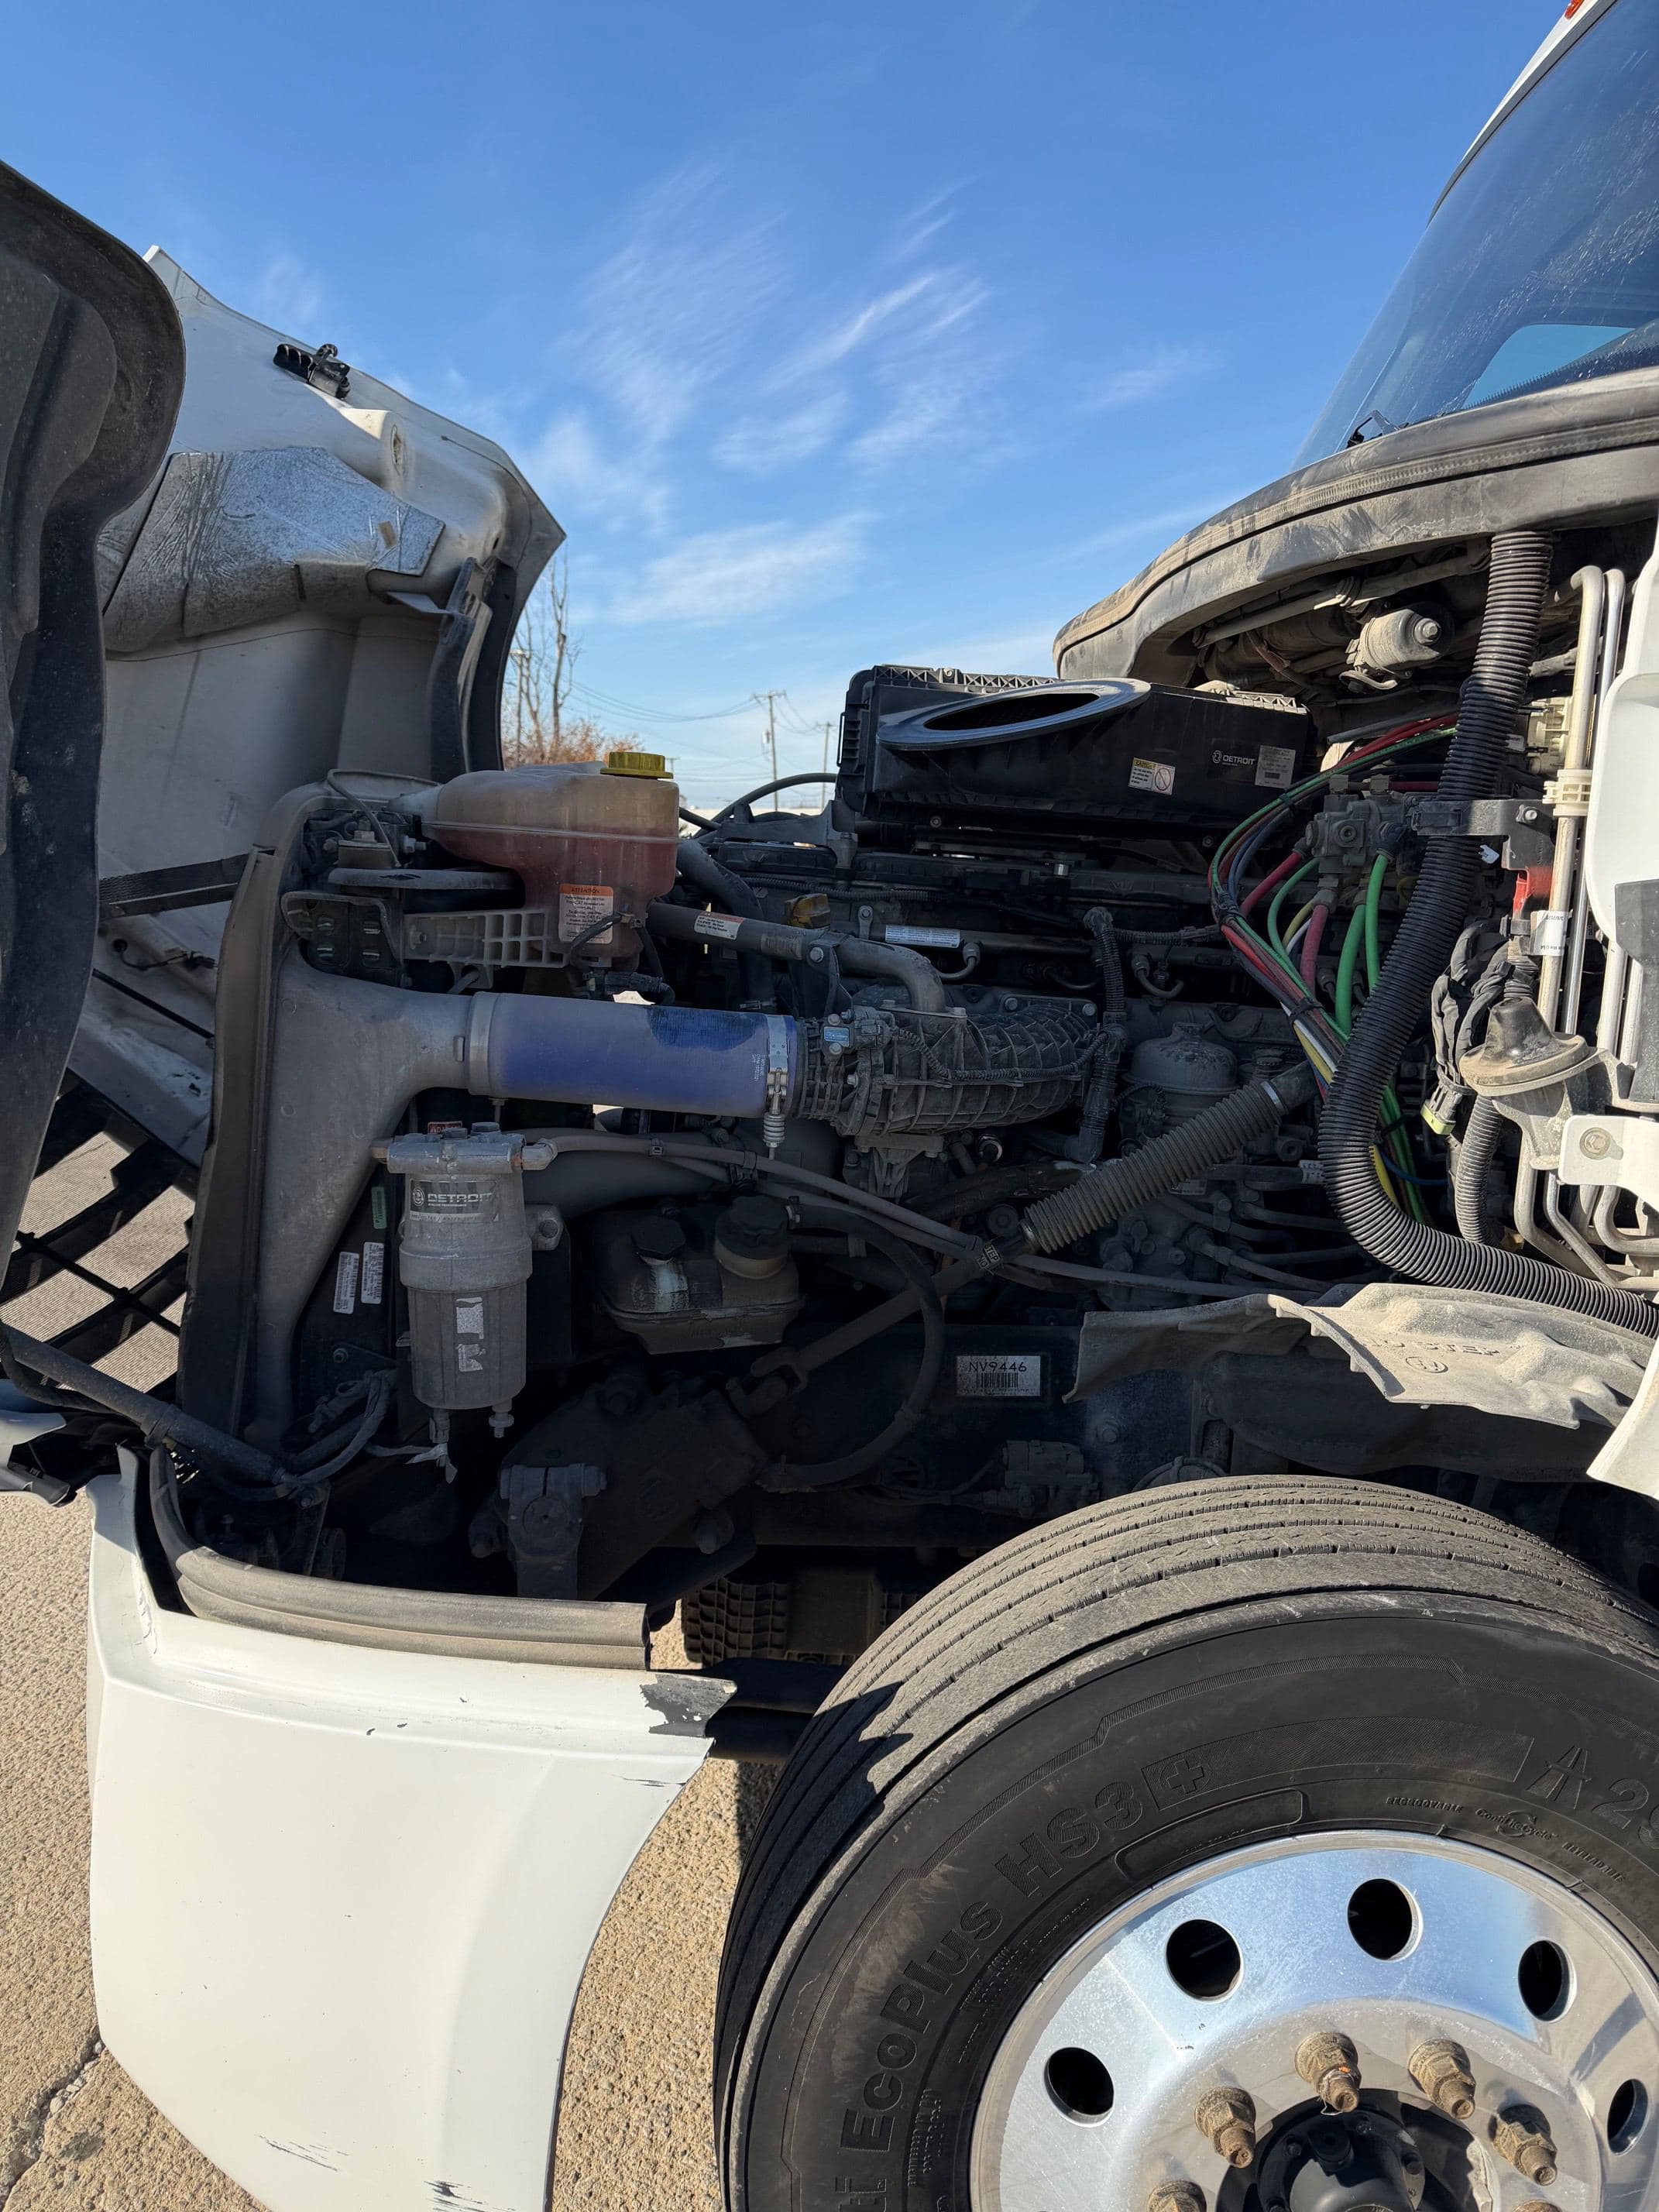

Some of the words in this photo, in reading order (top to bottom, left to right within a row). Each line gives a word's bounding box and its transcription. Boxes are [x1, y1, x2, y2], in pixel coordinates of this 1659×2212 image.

[1222, 754, 1255, 765] DETROIT
[427, 1192, 493, 1203] DETROIT
[969, 1362, 1027, 1372] NV9446
